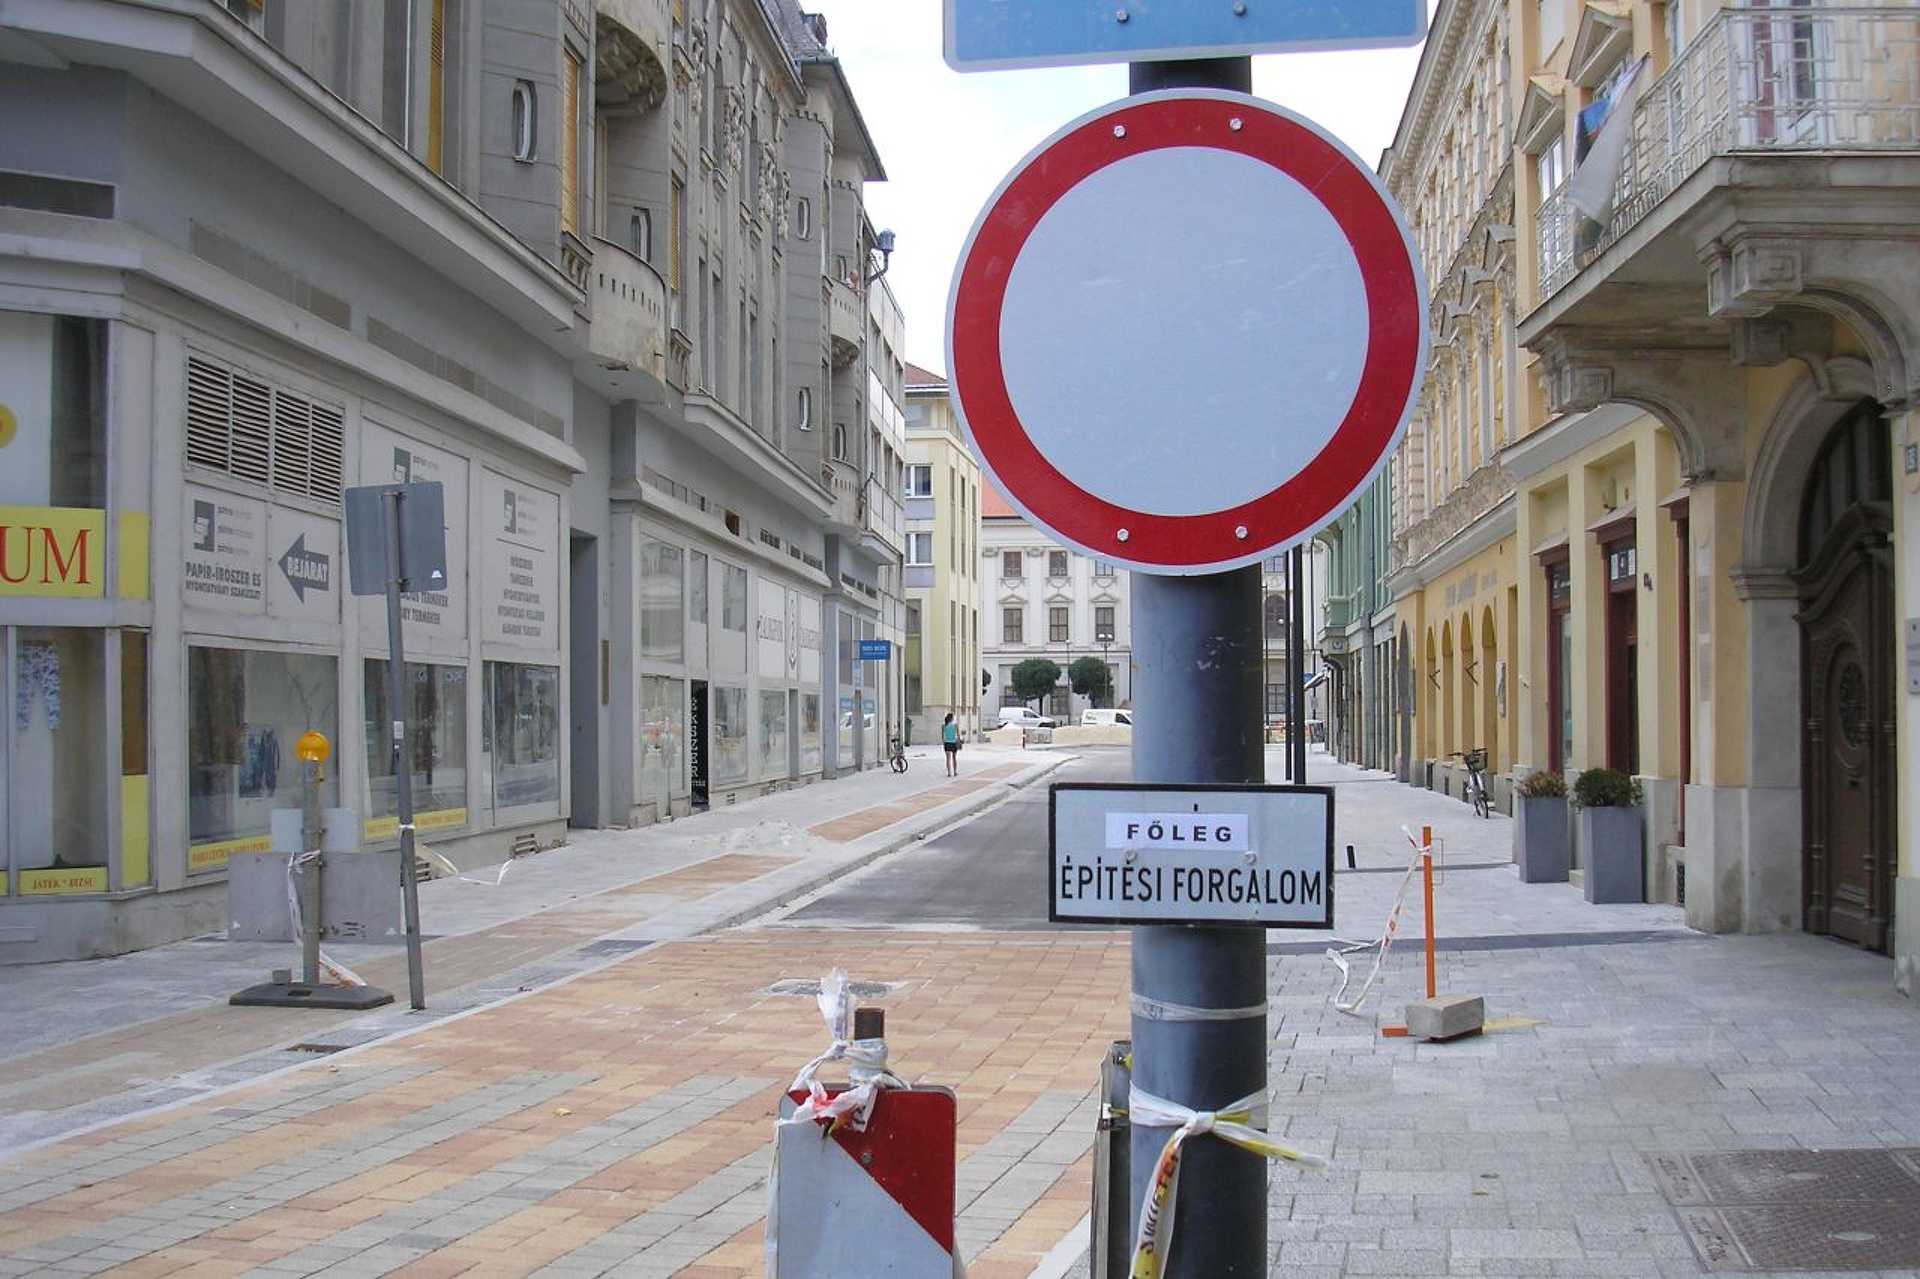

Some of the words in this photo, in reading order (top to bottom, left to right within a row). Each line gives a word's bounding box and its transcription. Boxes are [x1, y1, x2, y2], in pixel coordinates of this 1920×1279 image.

[0, 526, 92, 584] UM
[1126, 819, 1232, 843] FŐLEG
[1061, 855, 1162, 902] ÉPÍTÉSI
[1173, 867, 1321, 905] FORGALOM
